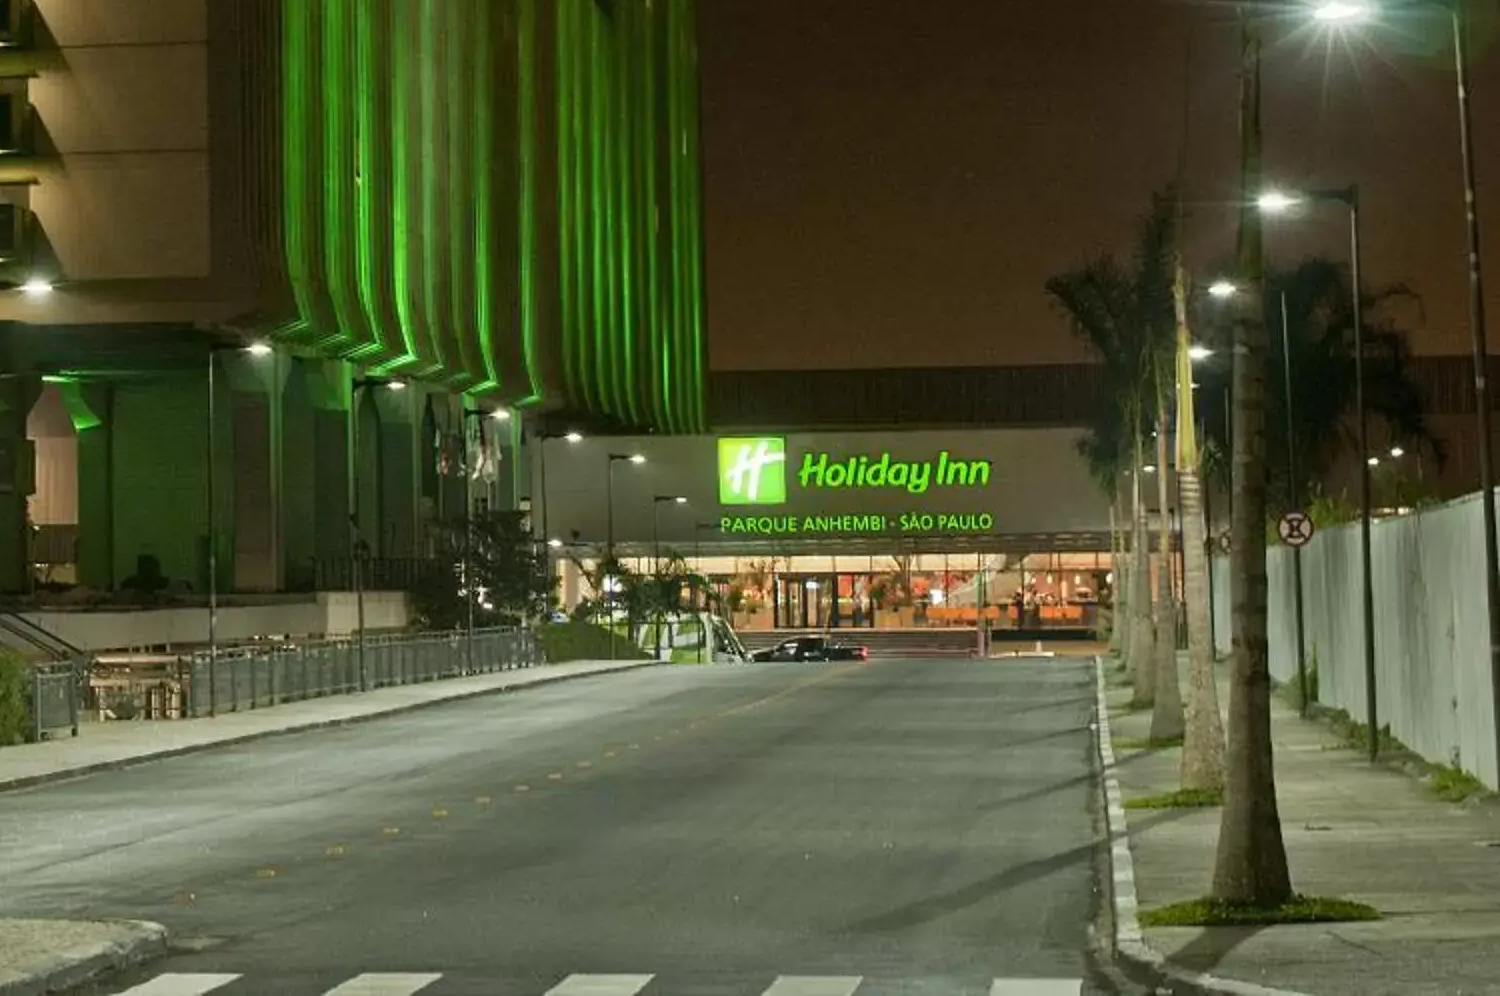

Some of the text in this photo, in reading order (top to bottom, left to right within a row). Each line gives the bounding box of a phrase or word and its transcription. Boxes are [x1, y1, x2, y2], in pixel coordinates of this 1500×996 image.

[798, 451, 991, 493] Holiday Inn
[720, 511, 993, 534] PARQUE ANHEMBI SÃO PAULO
